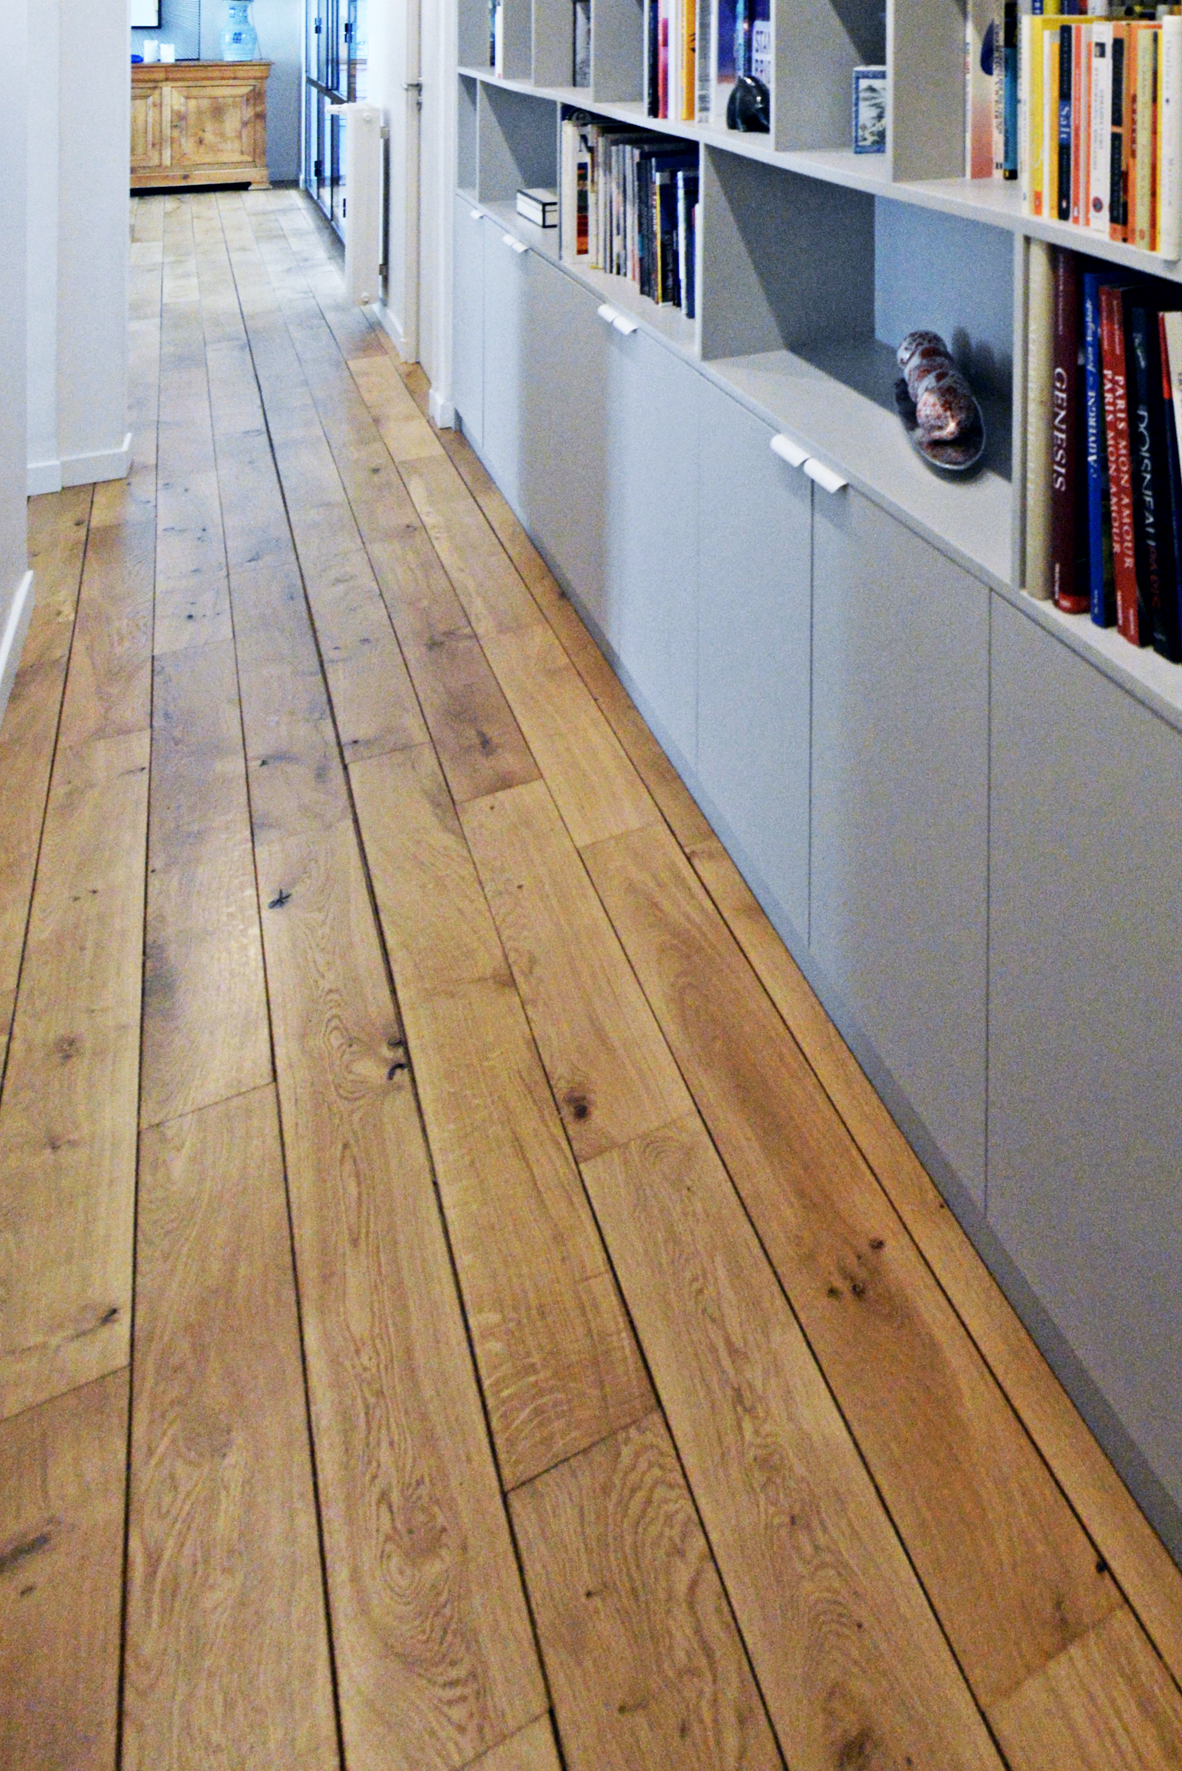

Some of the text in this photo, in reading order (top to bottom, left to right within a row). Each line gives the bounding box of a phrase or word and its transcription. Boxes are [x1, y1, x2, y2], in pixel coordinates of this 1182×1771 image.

[1060, 105, 1070, 141] Salt
[1052, 367, 1068, 491] GENESIS
[1102, 369, 1120, 554] PARIS MON AMOUR
[1112, 375, 1133, 568] PARIS MON AMOUR
